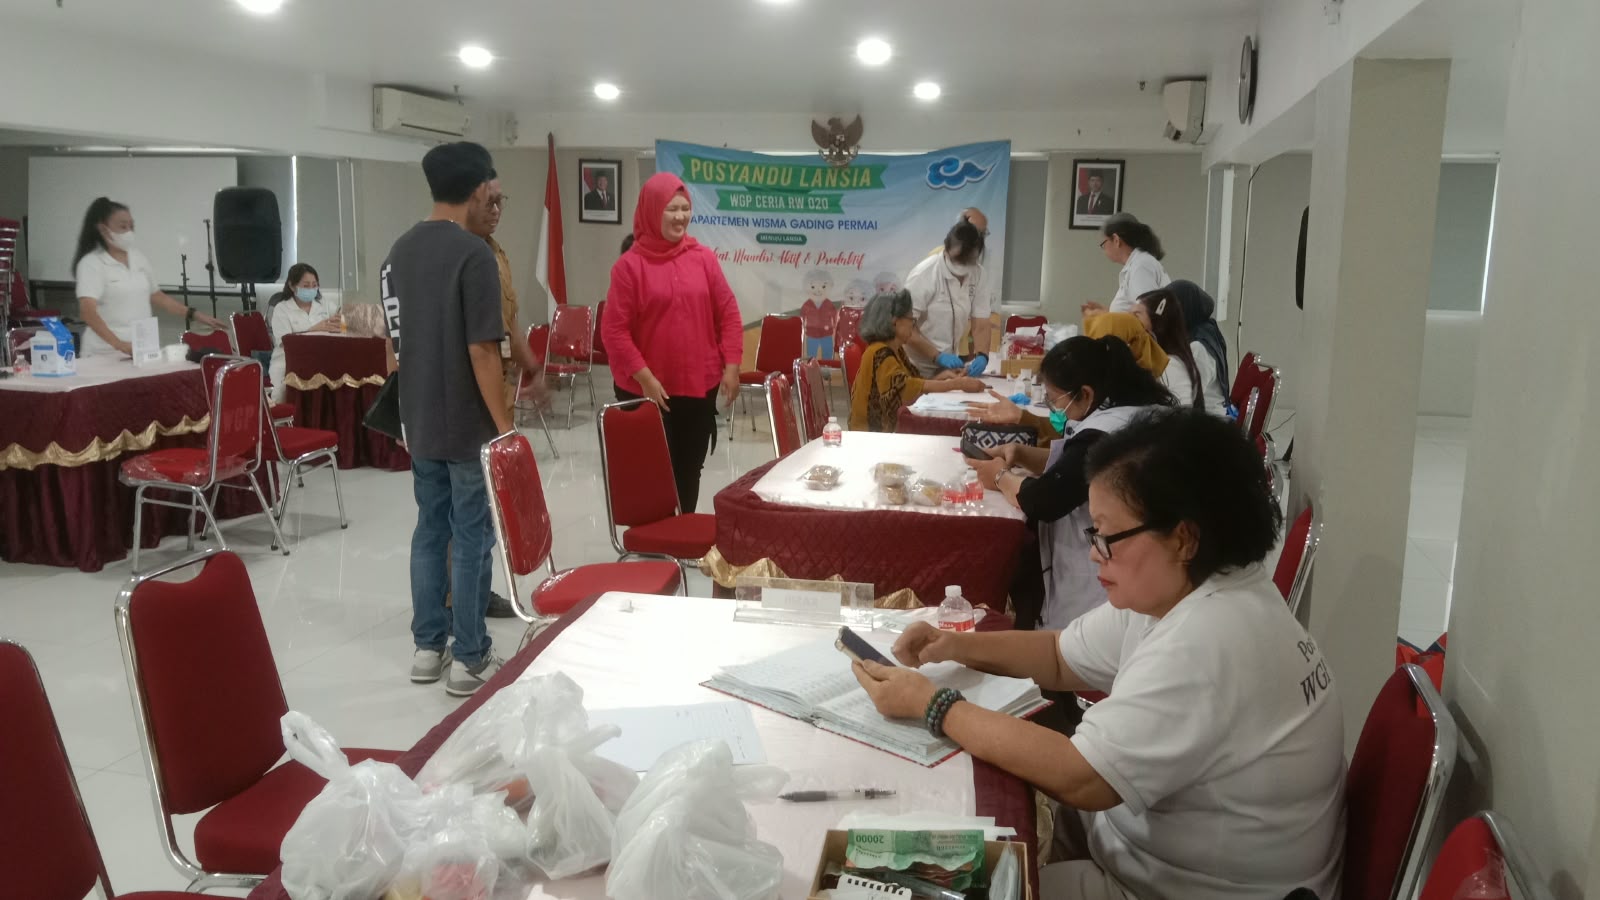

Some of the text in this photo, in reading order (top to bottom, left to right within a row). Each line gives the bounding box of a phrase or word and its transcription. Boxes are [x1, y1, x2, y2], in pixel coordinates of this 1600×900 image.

[690, 158, 871, 188] POSYANDU LANSIA
[730, 194, 829, 210] WGP CERIA RW 020
[690, 214, 878, 231] APARTEMEN WISMA GADING PERMAI
[855, 834, 884, 844] 20000
